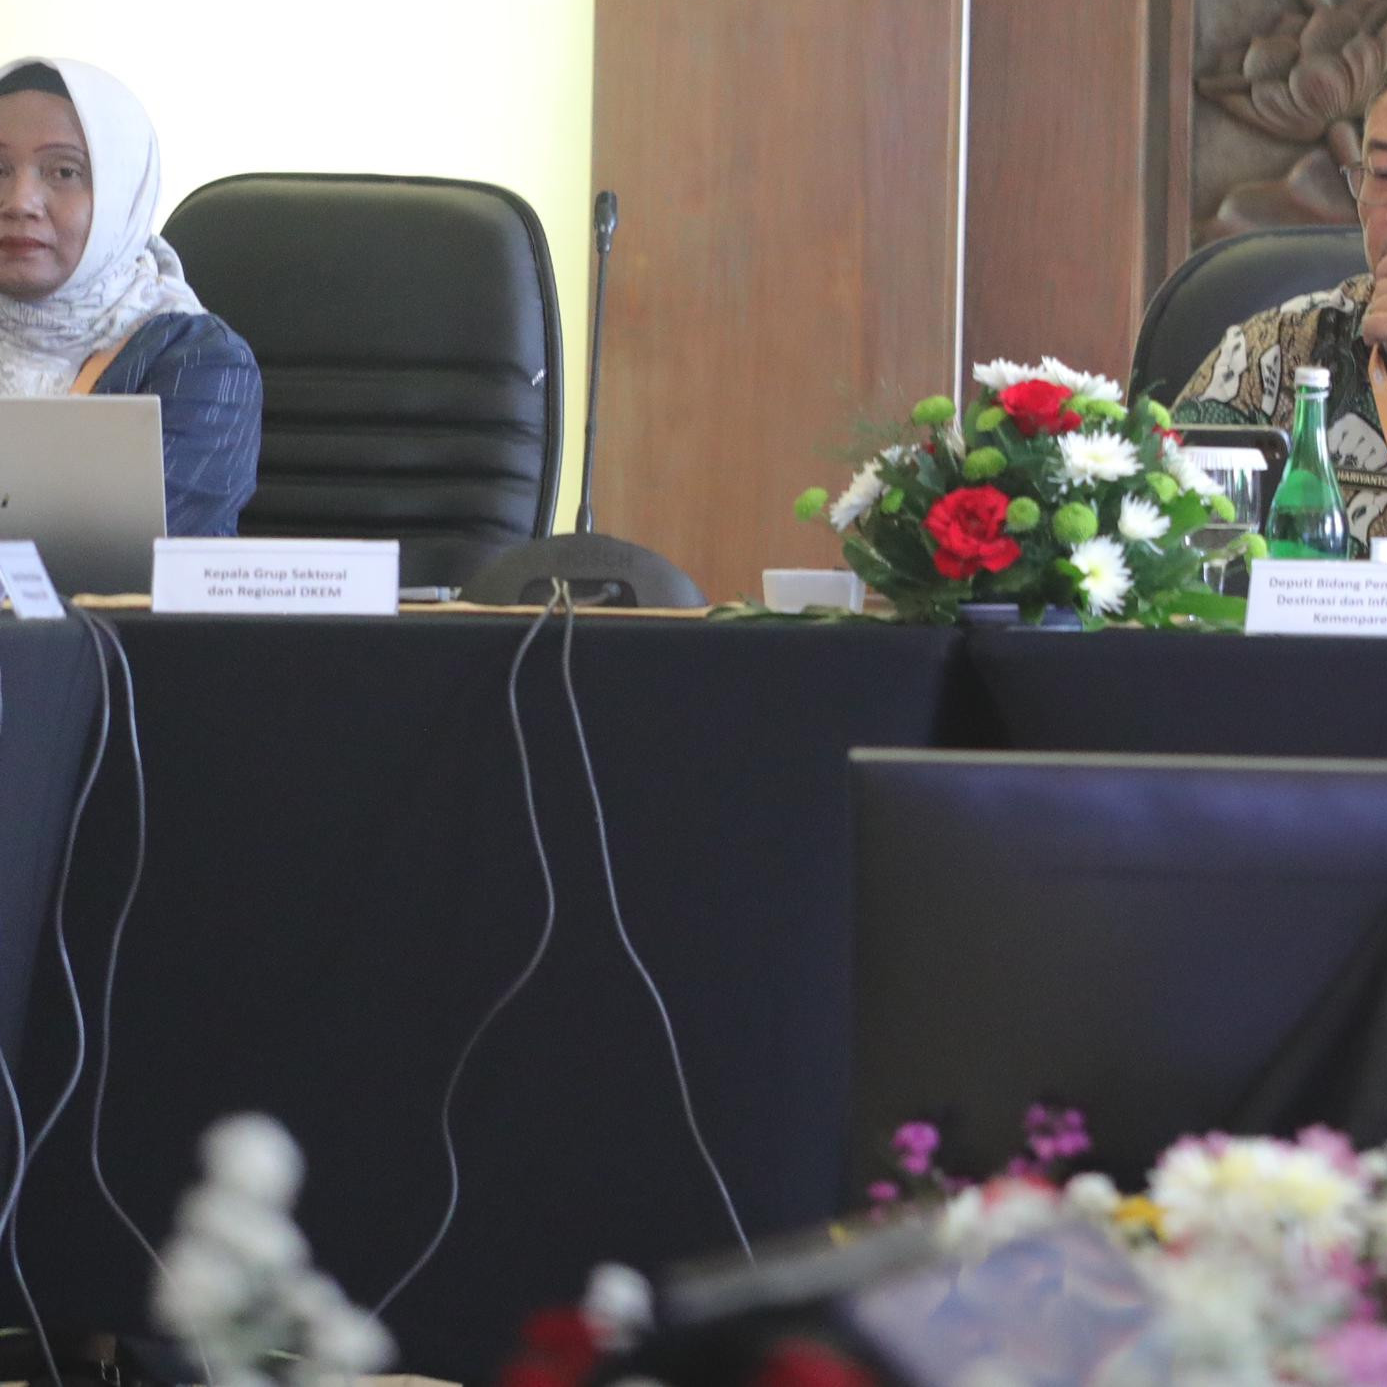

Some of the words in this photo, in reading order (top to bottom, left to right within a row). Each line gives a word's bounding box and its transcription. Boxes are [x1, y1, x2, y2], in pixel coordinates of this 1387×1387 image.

[204, 568, 250, 581] Kepala
[254, 568, 287, 581] Grup
[292, 568, 347, 580] Sektoral
[1269, 577, 1313, 590] Deputi
[1316, 578, 1360, 591] Bidang
[208, 586, 233, 597] dan
[238, 586, 296, 599] Regional
[300, 586, 342, 597] DKEM
[1277, 594, 1335, 606] Destinasi
[1340, 595, 1363, 606] dan
